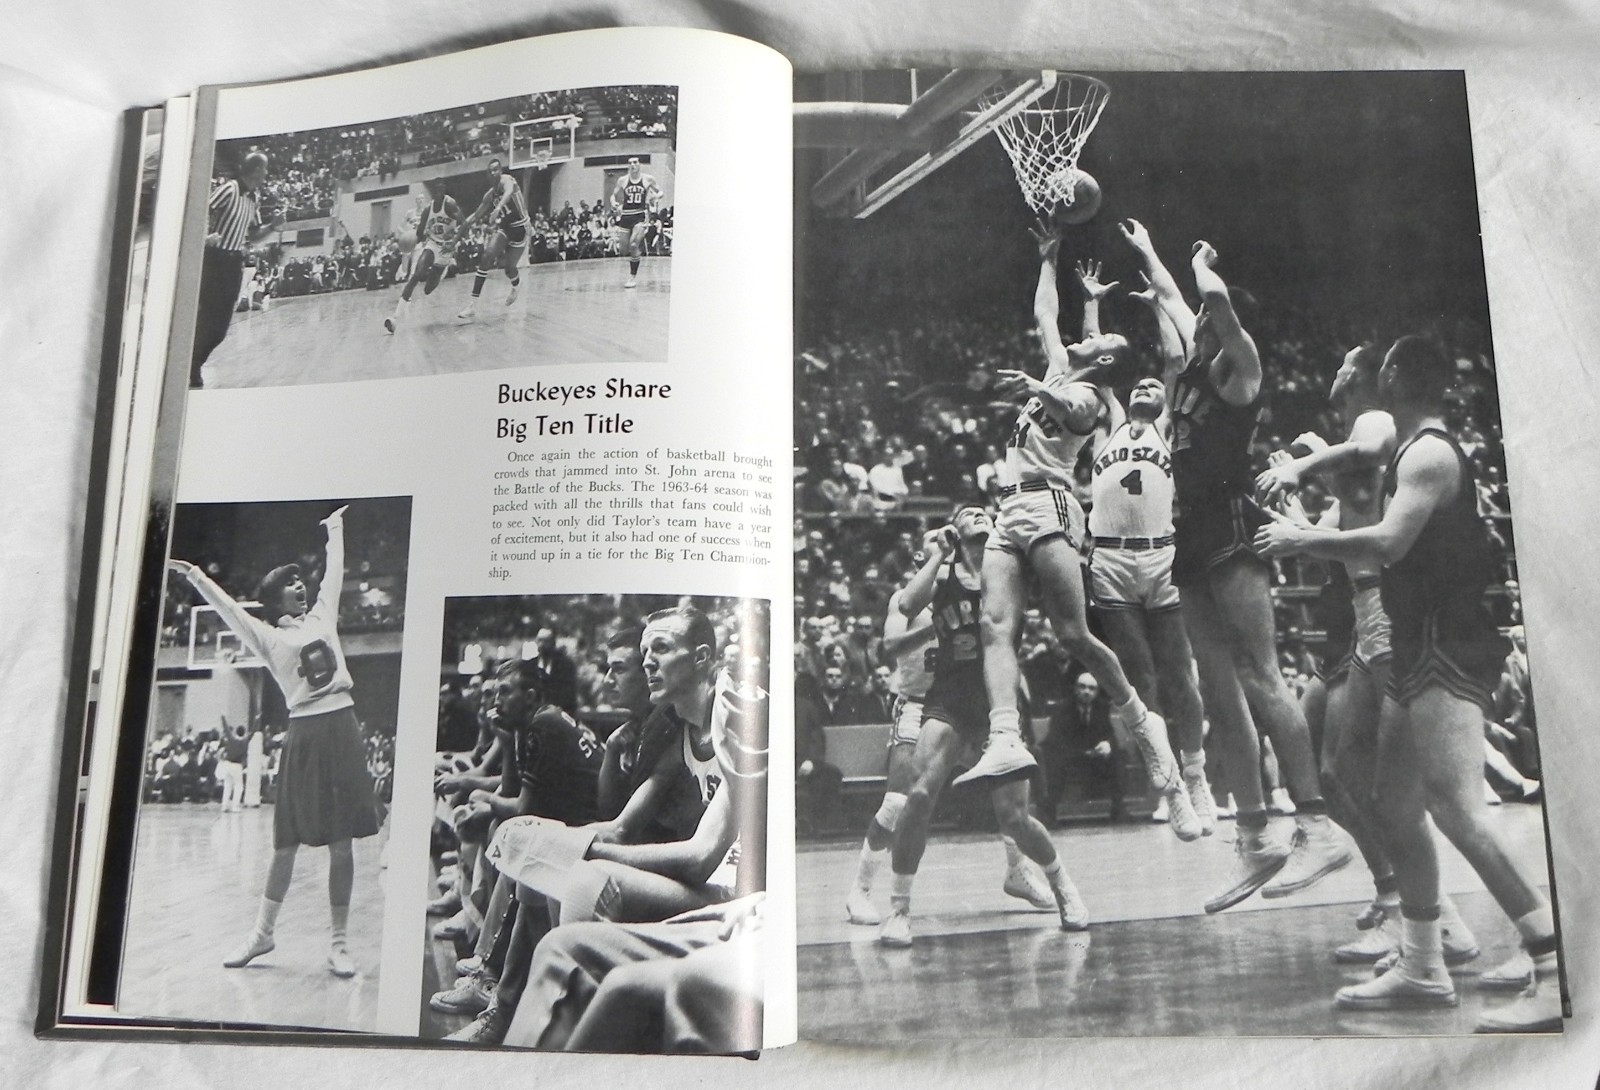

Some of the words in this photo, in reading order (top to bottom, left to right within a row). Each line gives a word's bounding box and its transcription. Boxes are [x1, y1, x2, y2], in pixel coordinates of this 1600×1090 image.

[627, 193, 642, 204] 30
[498, 382, 596, 405] Buckeyes
[605, 378, 672, 399] Share
[496, 417, 527, 442] Big
[536, 415, 573, 436] Ten
[584, 412, 634, 434] Title
[507, 452, 534, 462] Once
[541, 450, 570, 463] again
[578, 449, 596, 459] the
[604, 449, 638, 459] action
[647, 448, 659, 458] of
[667, 448, 725, 462] basketball
[733, 452, 773, 469] brought
[1094, 447, 1128, 476] OHIO
[494, 468, 529, 479] crowds
[535, 466, 556, 477] that
[563, 464, 608, 478] jammed
[615, 465, 637, 475] into
[645, 464, 660, 475] St.
[668, 464, 697, 478] John
[704, 469, 735, 479] arena
[743, 471, 753, 481] to
[758, 474, 772, 483] see
[1120, 469, 1142, 495] 4
[494, 485, 510, 495] the
[514, 484, 544, 494] Battle
[550, 482, 561, 493] of
[565, 482, 583, 492] the
[589, 481, 624, 492] Bucks.
[631, 481, 655, 492] The
[662, 481, 708, 494] 1963-64
[714, 486, 749, 496] season
[754, 490, 772, 500] was
[492, 501, 528, 515] packed
[534, 499, 557, 510] with
[564, 498, 578, 509] all
[585, 498, 602, 509] the
[609, 498, 643, 509] thrills
[651, 498, 674, 509] that
[682, 499, 706, 510] fans
[713, 501, 743, 513] could
[750, 505, 772, 516] wish
[492, 519, 502, 529] to
[507, 520, 525, 528] see.
[531, 517, 550, 527] Not
[557, 516, 580, 530] only
[587, 515, 605, 526] did
[612, 515, 660, 529] Taylor's
[667, 517, 697, 527] team
[704, 518, 731, 529] have
[751, 524, 771, 535] year
[491, 533, 503, 544] of
[504, 533, 564, 545] excitement,
[569, 532, 586, 543] but
[592, 532, 600, 542] it
[605, 532, 627, 542] also
[632, 532, 654, 542] had
[659, 534, 680, 542] one
[685, 533, 696, 543] of
[701, 536, 740, 545] success
[490, 551, 497, 561] it
[503, 550, 536, 561] wound
[541, 551, 555, 563] up
[560, 549, 570, 560] in
[575, 552, 582, 560] a
[588, 549, 602, 559] tie
[608, 548, 624, 559] for
[630, 549, 648, 559] the
[655, 549, 674, 562] Big
[680, 550, 704, 560] Ten
[488, 567, 512, 580] ship.
